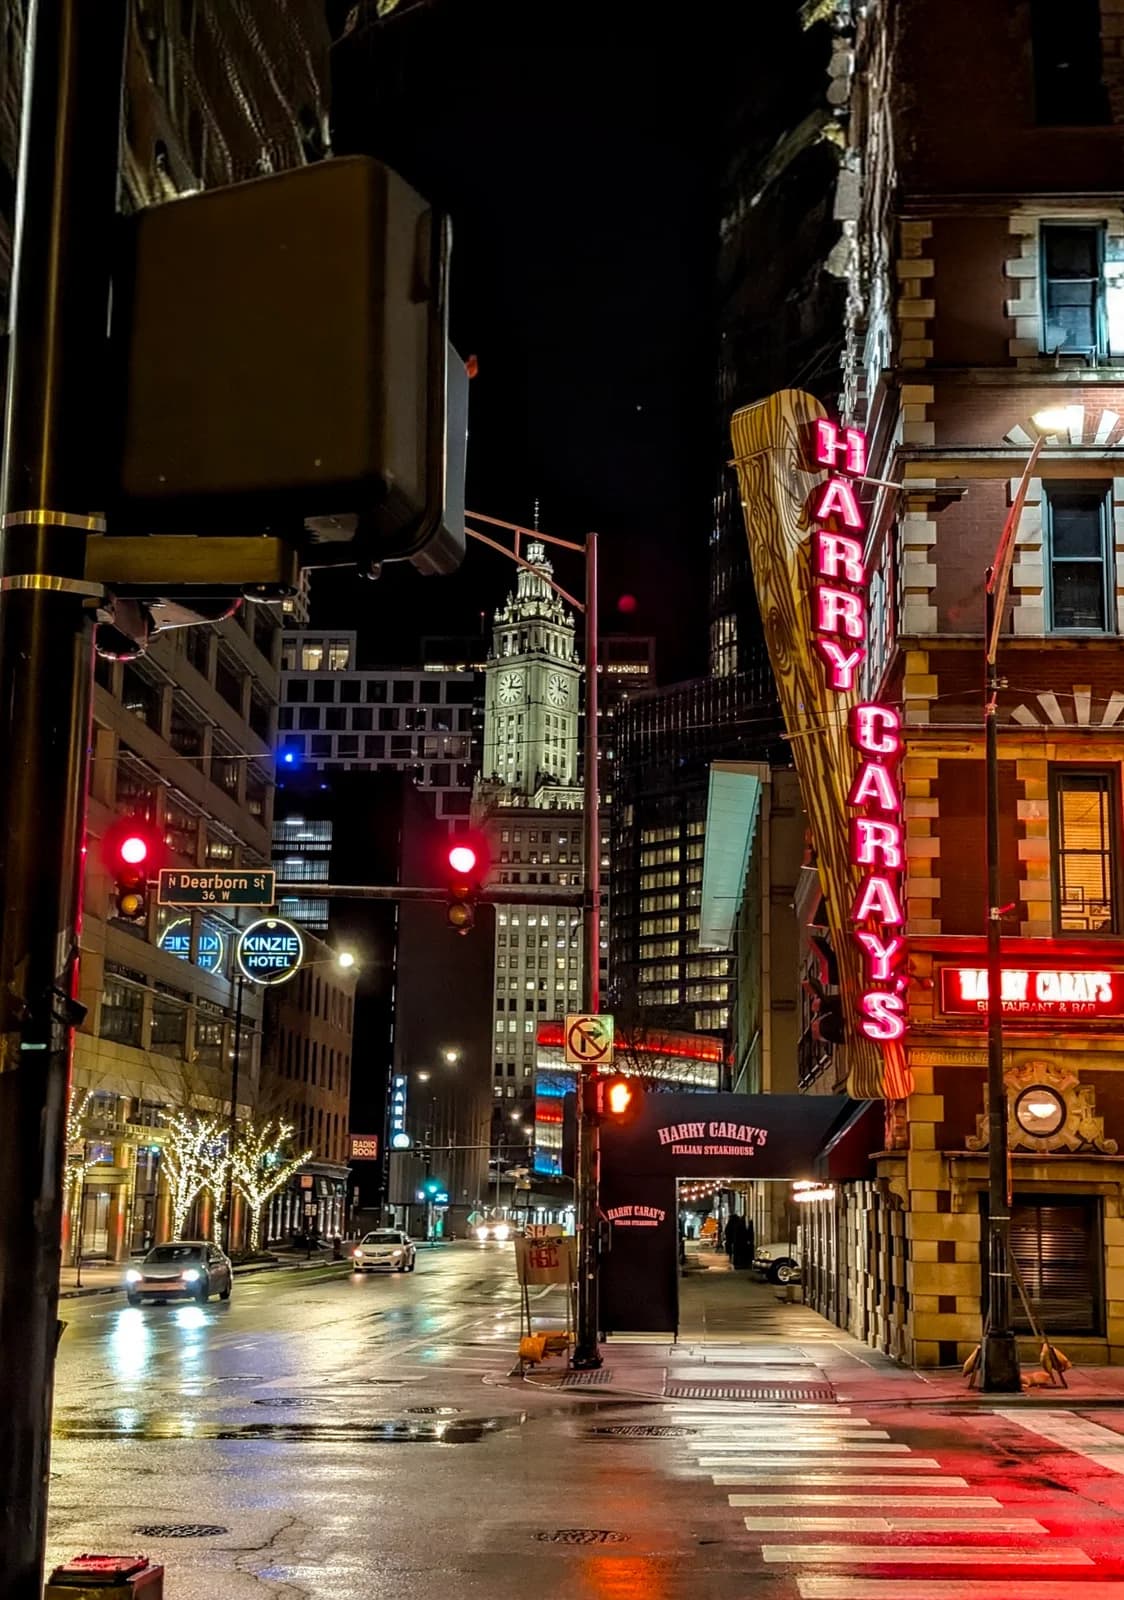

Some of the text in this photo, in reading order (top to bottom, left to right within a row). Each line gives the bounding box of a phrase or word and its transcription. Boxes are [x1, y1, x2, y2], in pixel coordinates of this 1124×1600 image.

[814, 417, 867, 691] HARRY
[853, 703, 908, 1040] CARAY'S
[168, 874, 266, 890] N Dearborn St
[202, 891, 230, 900] 36 W
[243, 937, 298, 951] KINZIE
[248, 955, 291, 968] HOTEL
[959, 970, 1028, 1000] HARY
[977, 1001, 1096, 1012] RTAURANT & BAR
[394, 1078, 404, 1129] PARK
[657, 1122, 768, 1146] HARRY CARAY'S
[352, 1140, 376, 1148] RADIO
[672, 1144, 754, 1156] ITALIAN STEAKHOUSE
[352, 1148, 376, 1156] ROOM
